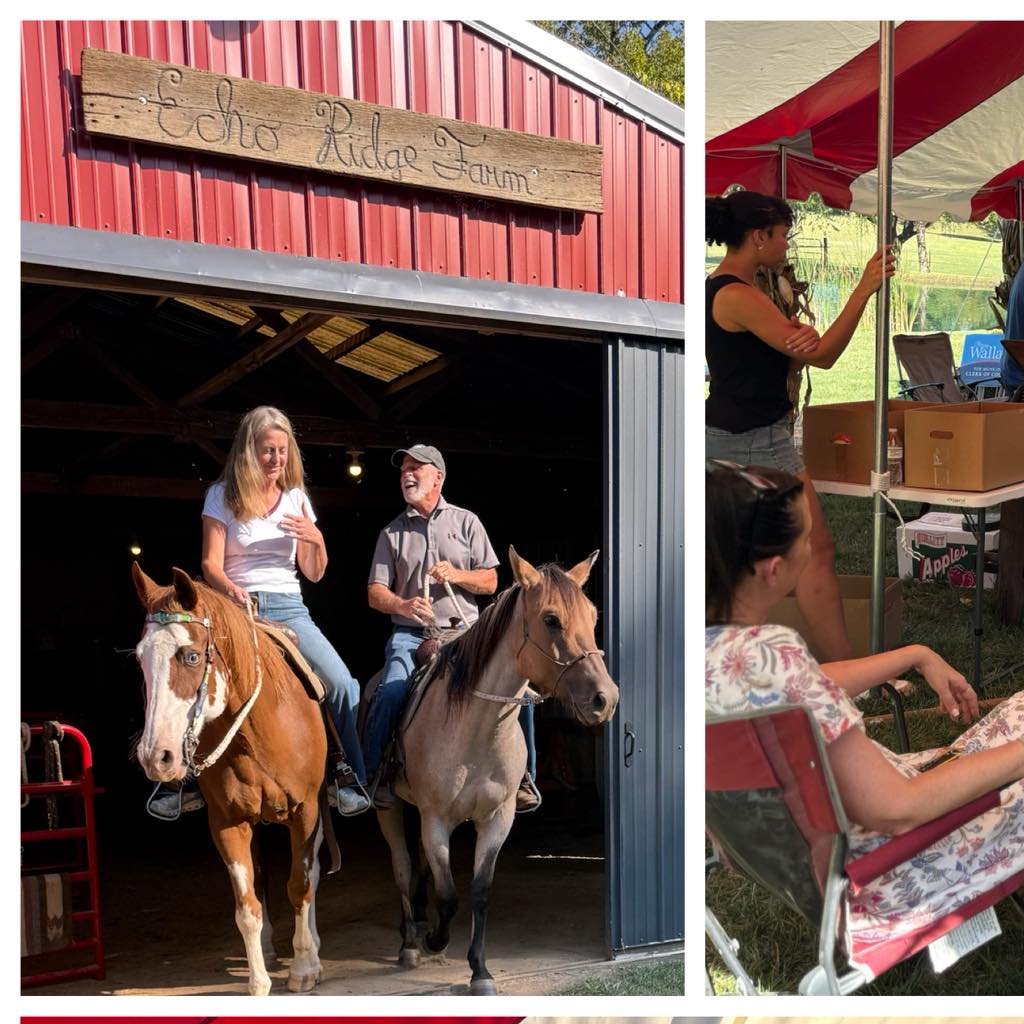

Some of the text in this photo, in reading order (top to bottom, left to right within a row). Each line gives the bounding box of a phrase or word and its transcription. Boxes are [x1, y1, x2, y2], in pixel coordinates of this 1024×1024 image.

[156, 67, 533, 196] Echo Ridge Farm
[970, 346, 1003, 360] Walla
